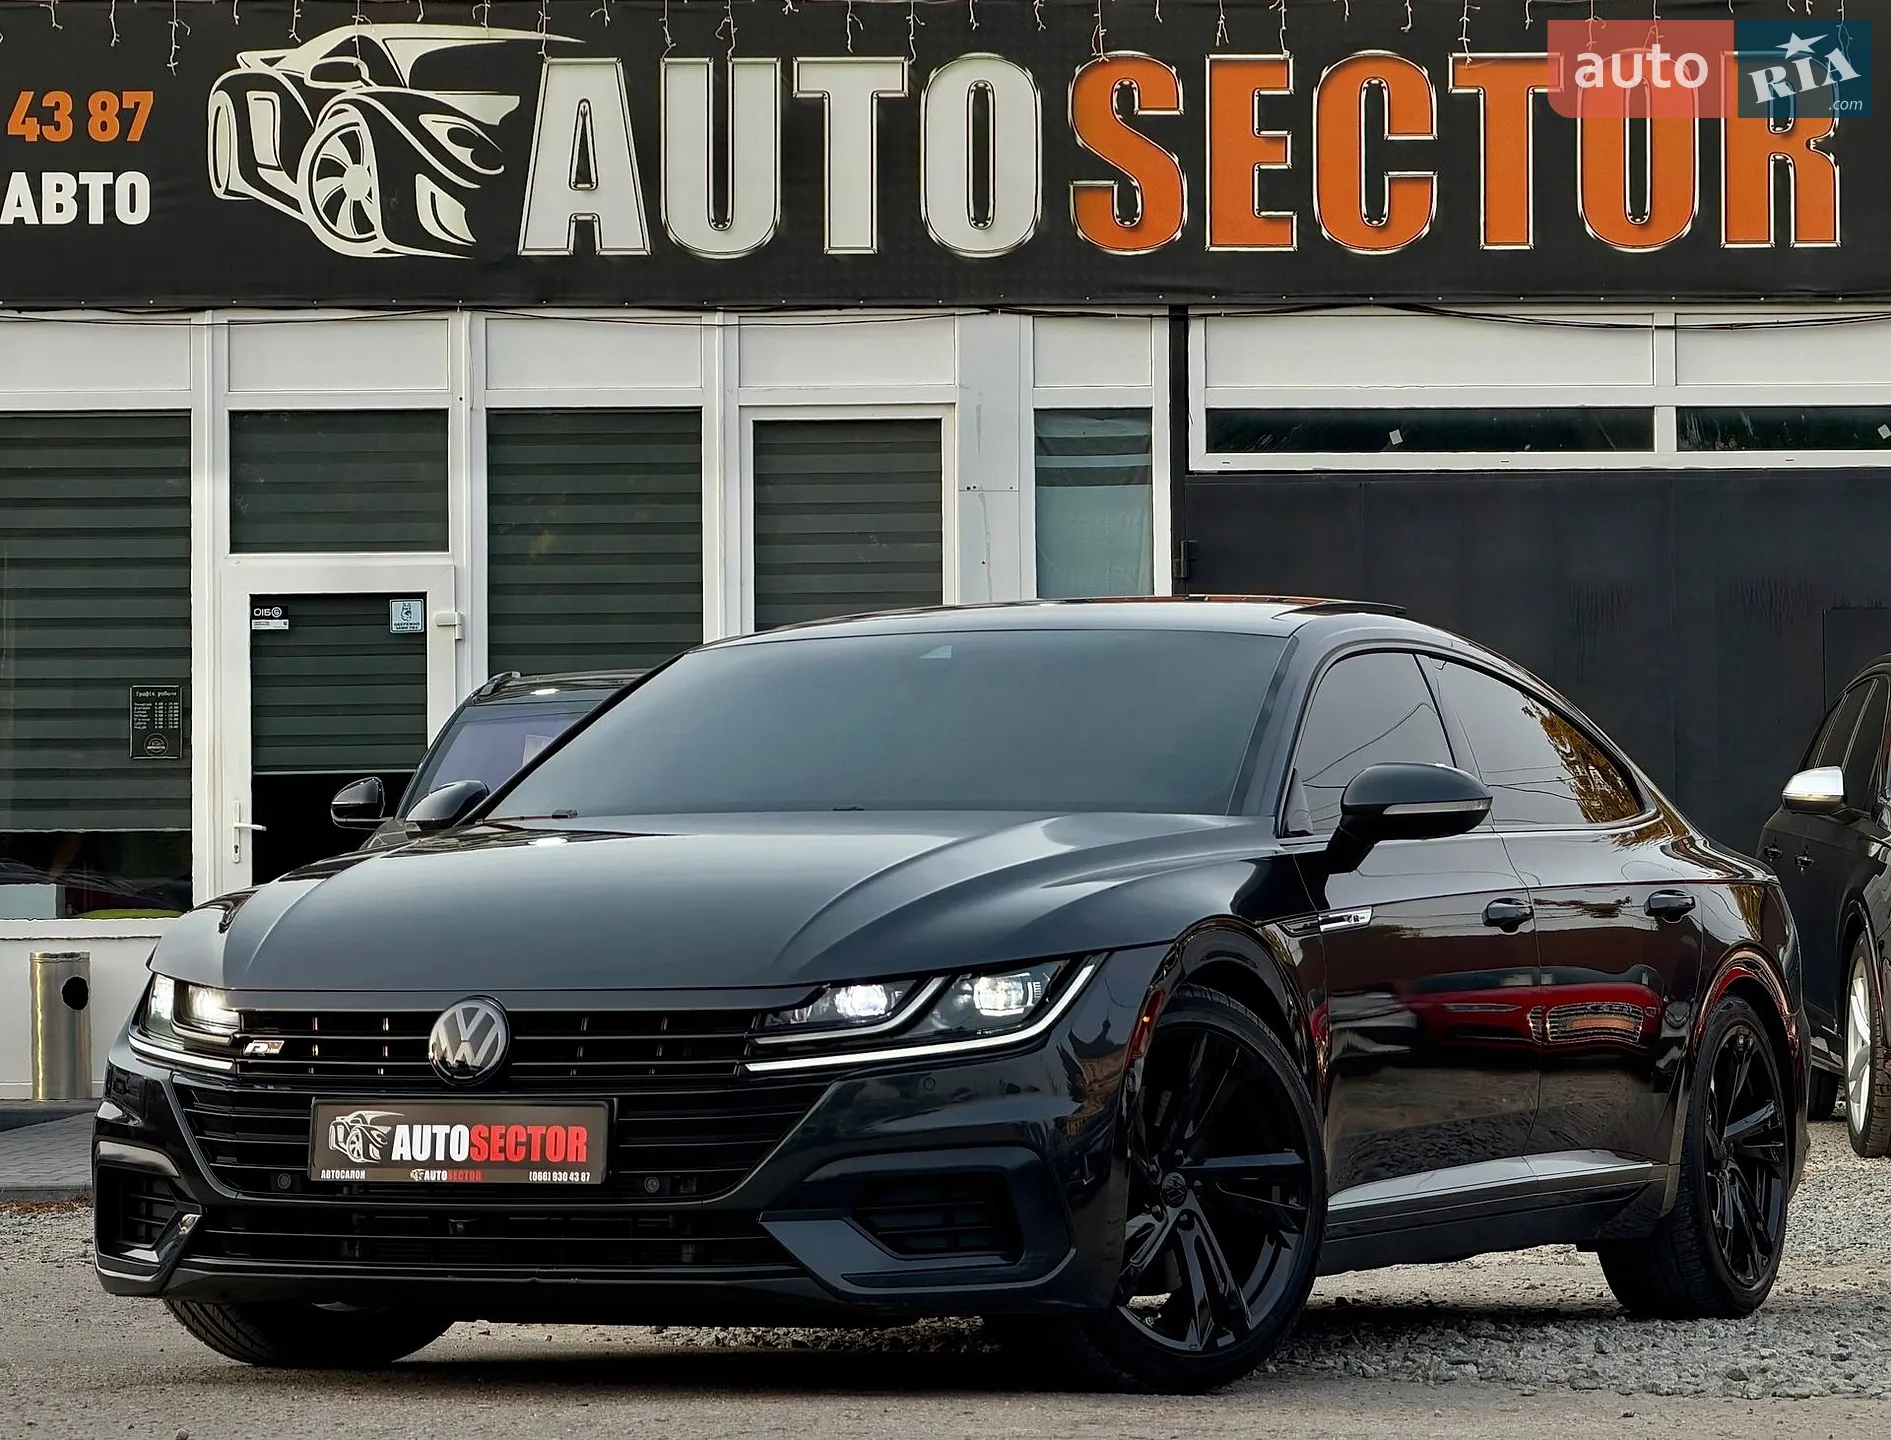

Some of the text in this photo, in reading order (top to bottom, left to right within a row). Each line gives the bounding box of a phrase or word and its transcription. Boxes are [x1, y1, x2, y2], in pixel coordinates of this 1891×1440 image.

[7, 90, 154, 142] 43 87
[518, 49, 1842, 259] AUTOSECTOR
[0, 170, 150, 225] АВТО
[391, 1124, 588, 1163] AUTOSECTOR
[320, 1169, 366, 1180] АВТОСАЛОН
[552, 1171, 568, 1182] 930
[569, 1172, 579, 1182] 43
[580, 1172, 591, 1182] 87
